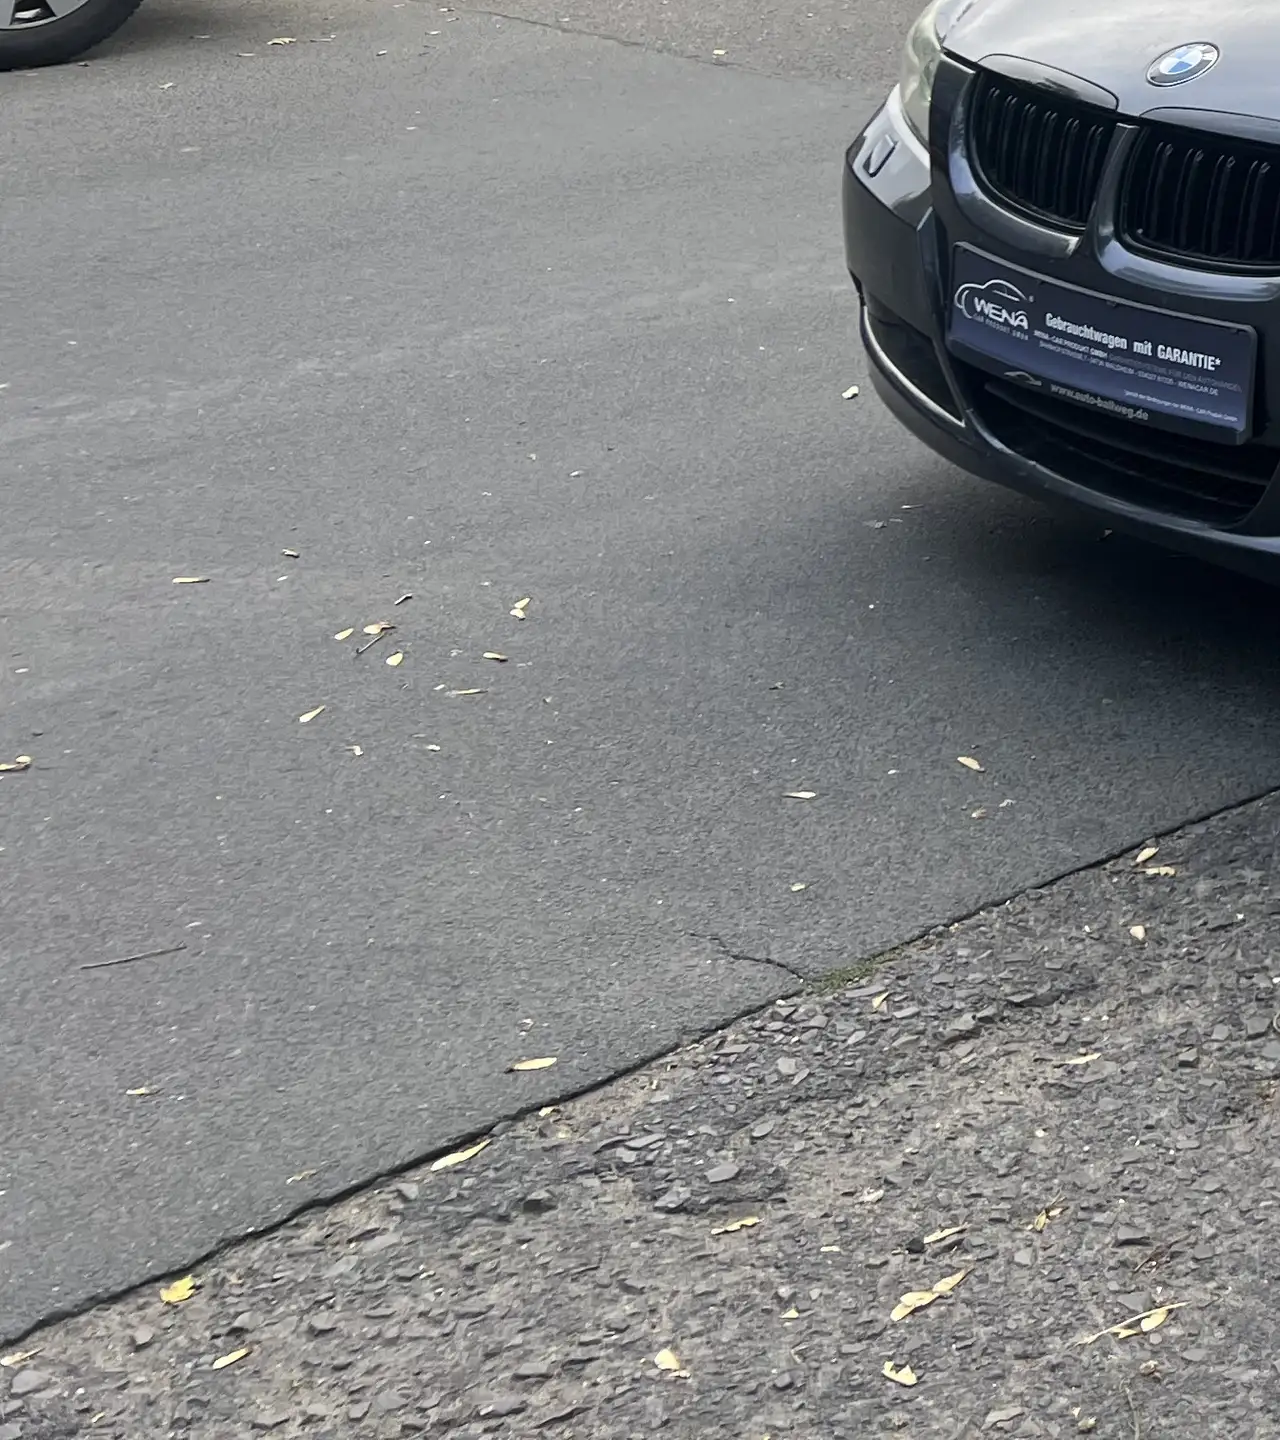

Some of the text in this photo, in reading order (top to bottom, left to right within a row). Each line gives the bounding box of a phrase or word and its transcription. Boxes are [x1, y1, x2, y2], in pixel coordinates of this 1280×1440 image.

[974, 296, 1029, 330] WENA
[1045, 312, 1128, 350] Gebrauchtwagen
[1133, 340, 1153, 357] mit
